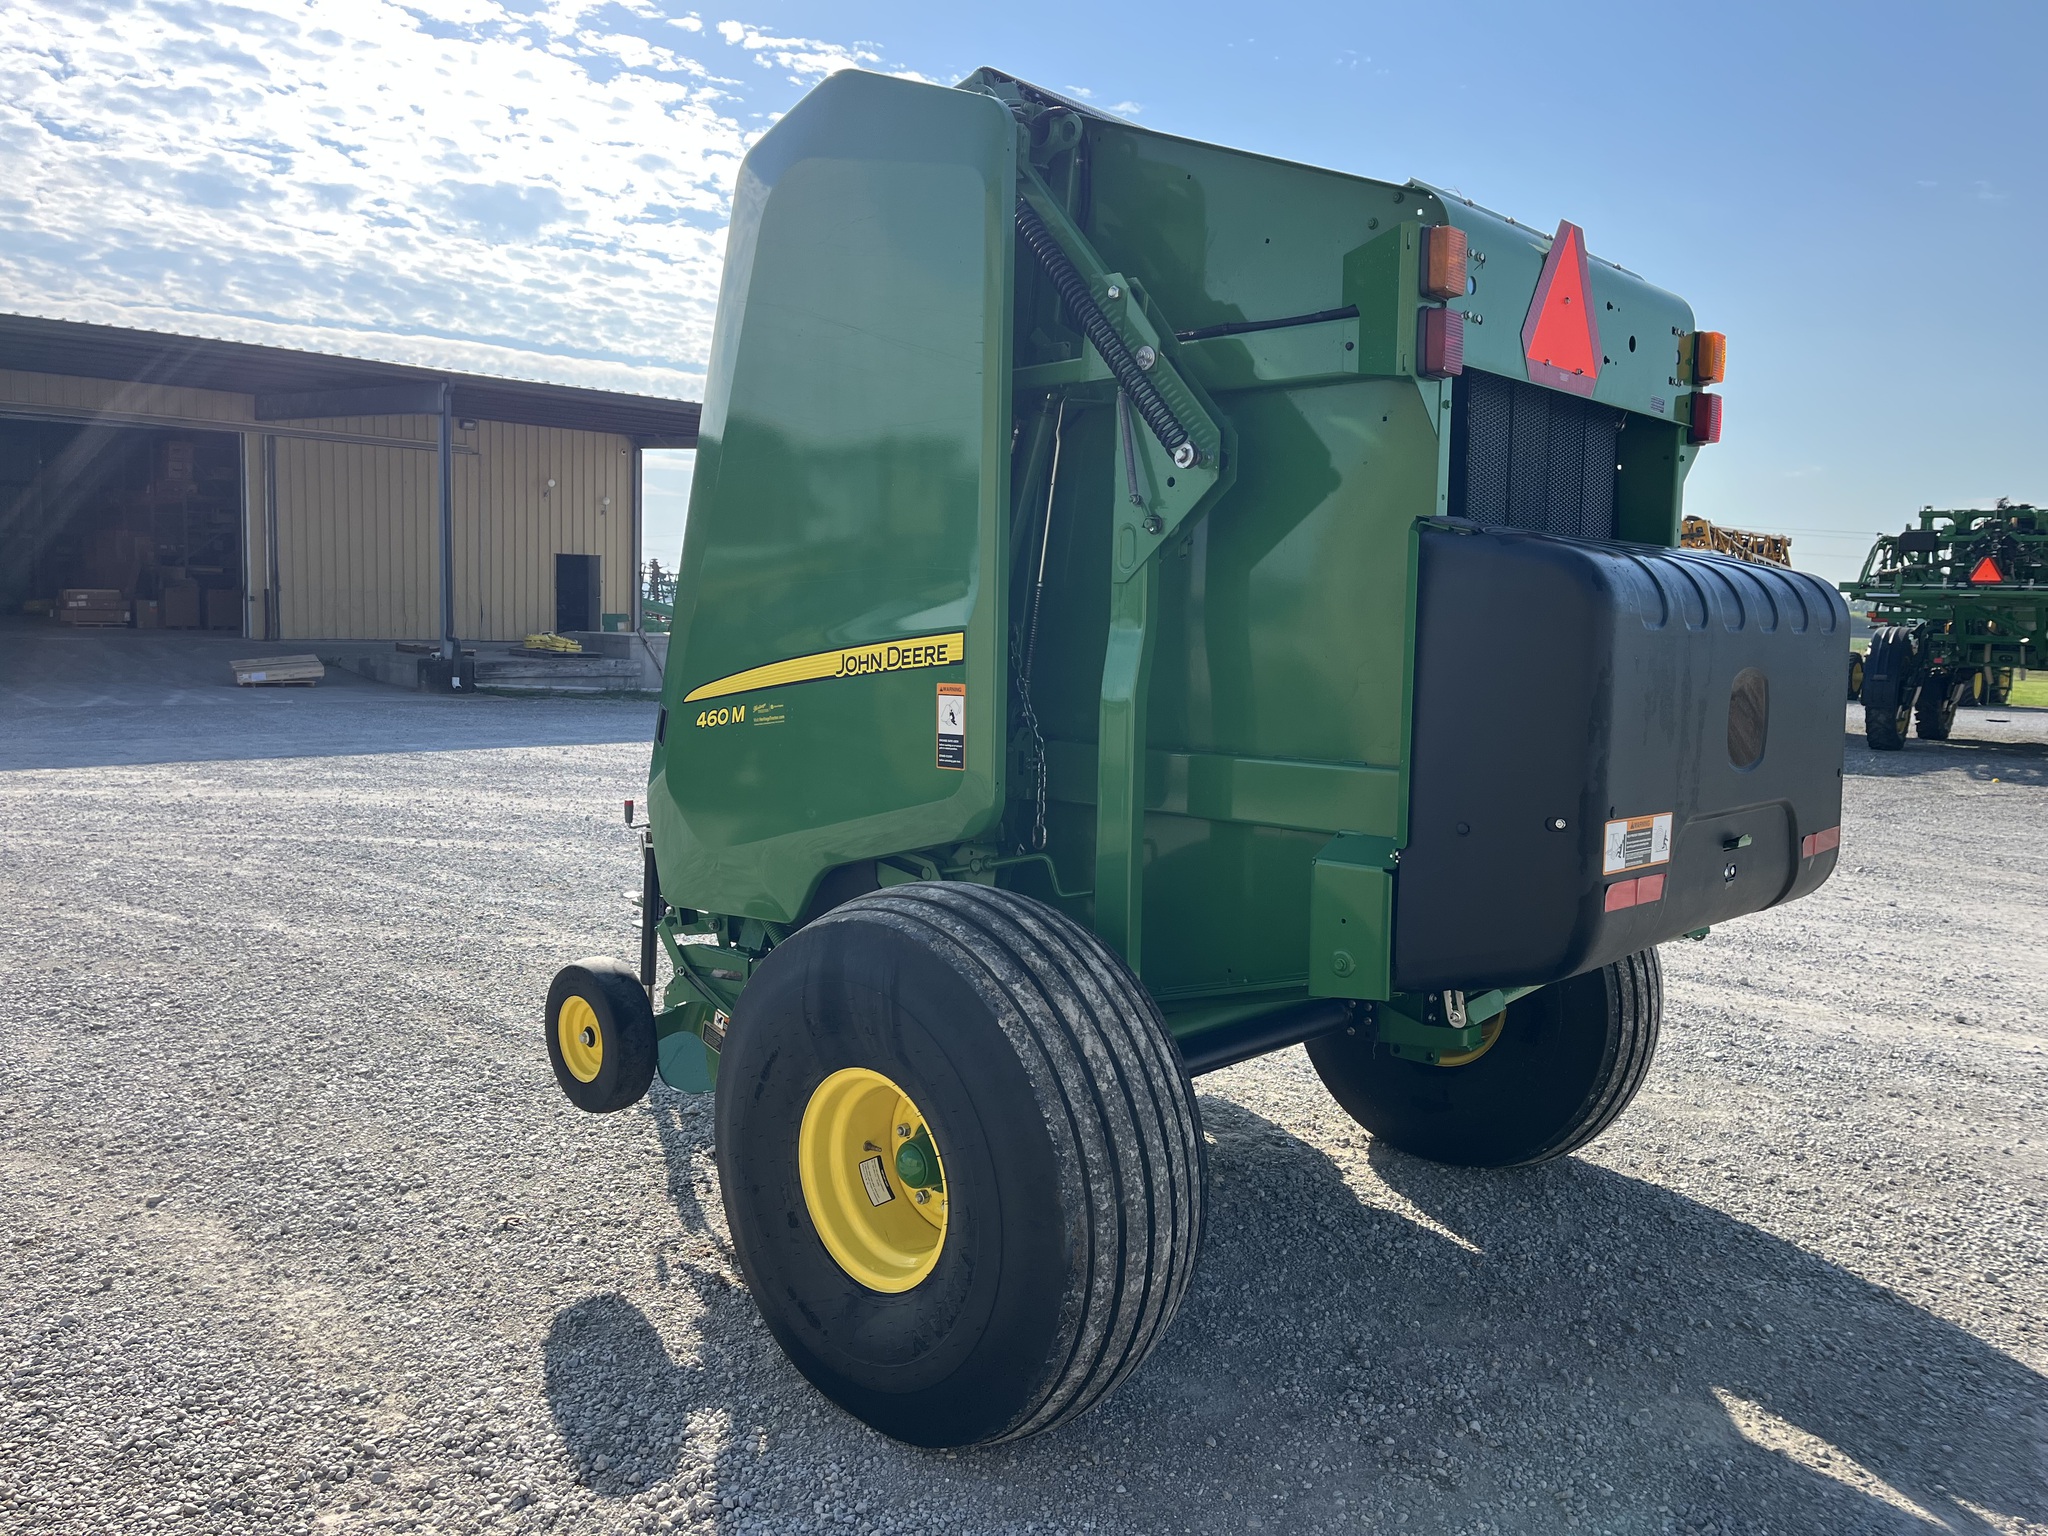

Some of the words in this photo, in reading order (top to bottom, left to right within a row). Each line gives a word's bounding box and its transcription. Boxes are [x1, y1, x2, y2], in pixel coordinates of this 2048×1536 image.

[836, 652, 882, 675] JOHN
[887, 644, 949, 667] DEERE
[696, 708, 730, 728] 460
[731, 705, 746, 724] M
